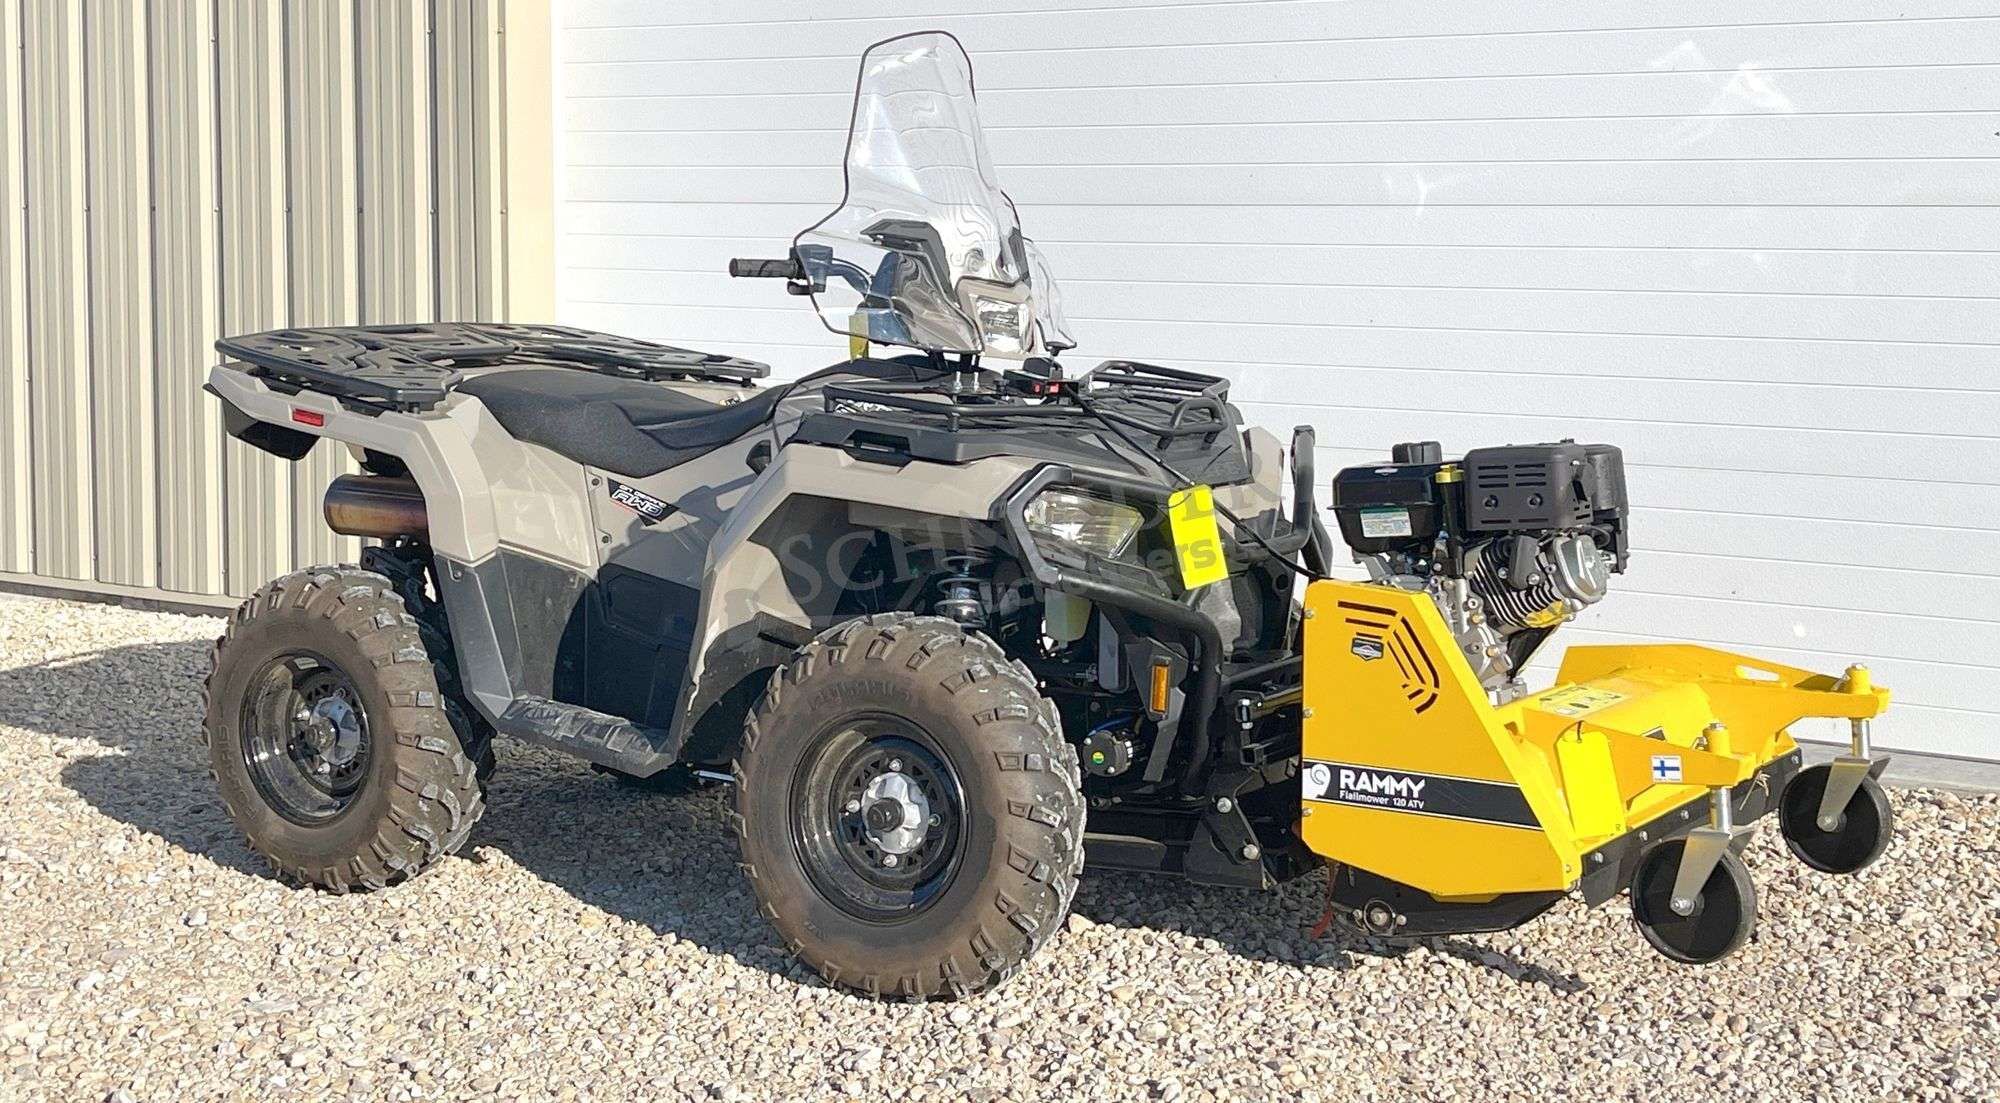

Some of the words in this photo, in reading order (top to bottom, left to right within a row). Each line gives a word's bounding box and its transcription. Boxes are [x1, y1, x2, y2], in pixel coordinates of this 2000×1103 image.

[611, 488, 664, 517] AWD
[1339, 769, 1426, 799] RAMMY
[1339, 789, 1390, 805] Flailmower
[1392, 797, 1407, 807] 120
[1407, 799, 1425, 810] ATV
